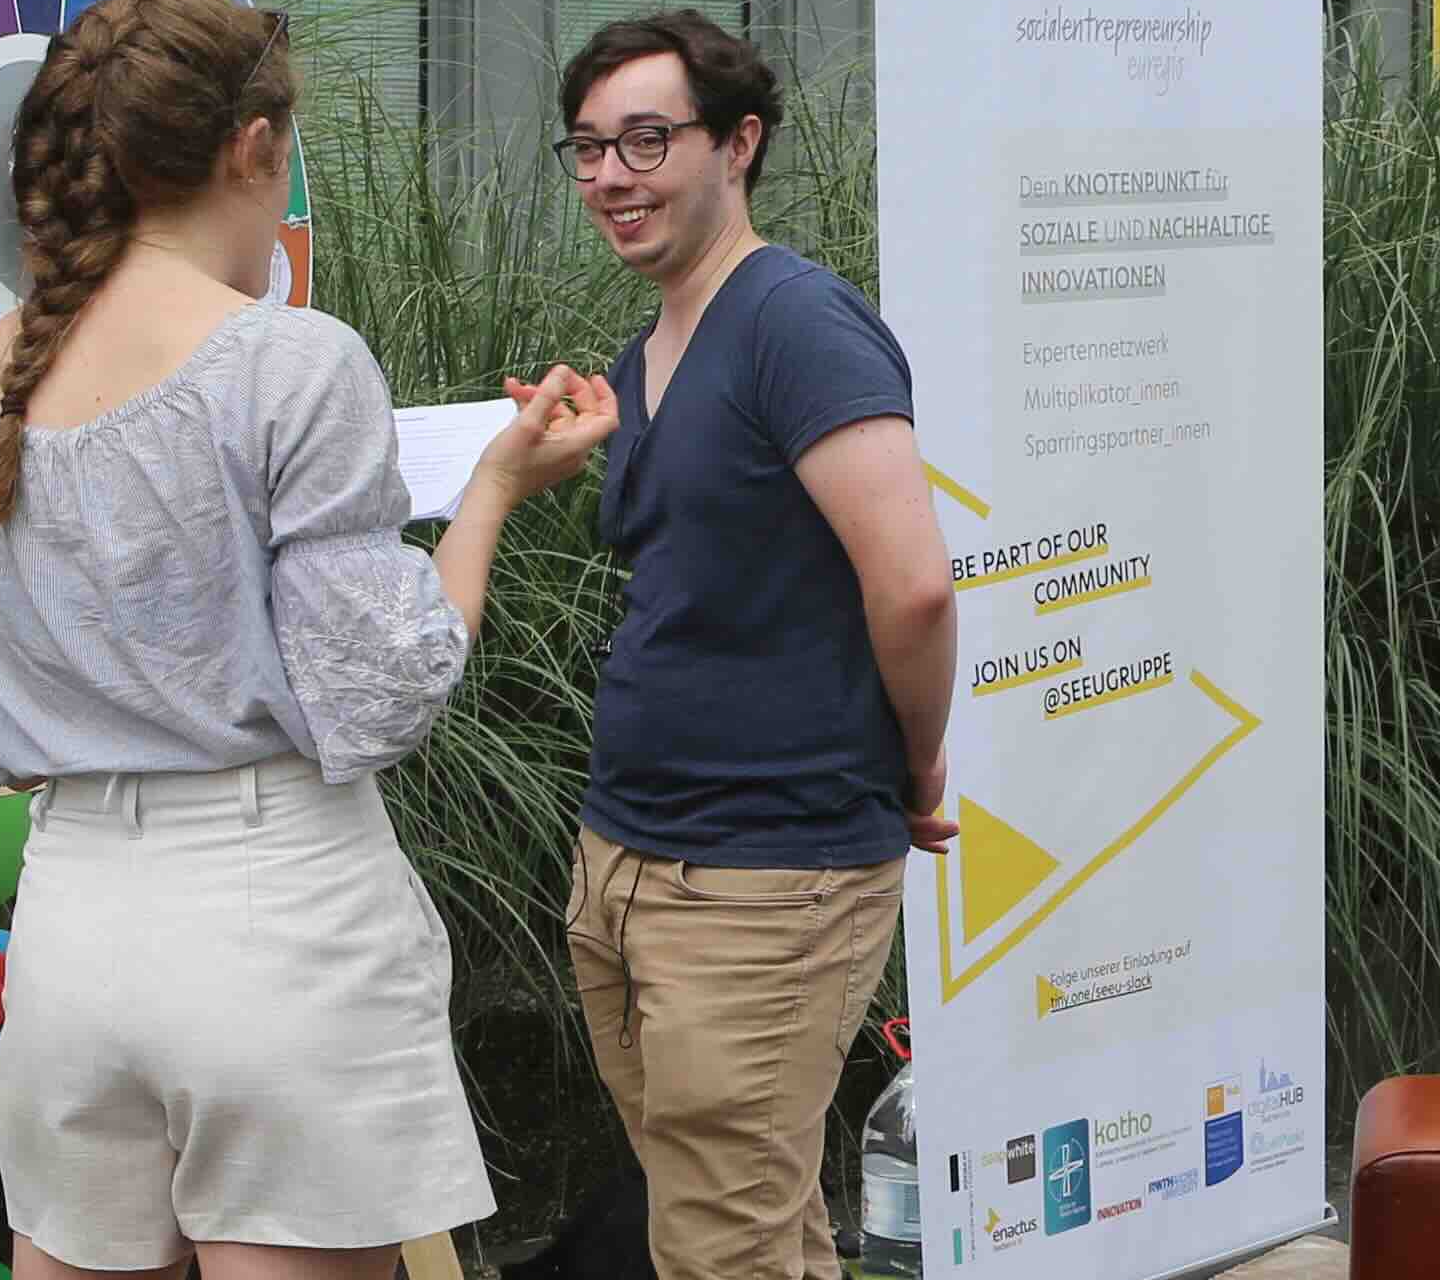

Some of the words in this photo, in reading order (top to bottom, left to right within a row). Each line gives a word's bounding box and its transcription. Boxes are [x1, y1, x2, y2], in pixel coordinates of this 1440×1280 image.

[1015, 4, 1213, 56] socialentrepreneurship
[1019, 173, 1059, 200] Dein
[1064, 169, 1201, 197] KNOTENPUNKT
[1204, 167, 1229, 193] für
[1020, 221, 1098, 249] SOZIALE
[1103, 218, 1146, 244] UND
[1149, 213, 1271, 240] NACHHALTIGE
[1021, 264, 1167, 295] INNOVATIONEN
[1022, 332, 1170, 368] Expertennetzwerk
[1024, 378, 1181, 413] Multiplikator_innen
[1024, 418, 1211, 461] Sparringspartner_innen
[951, 557, 977, 582] BE
[983, 541, 1032, 575] PART
[1036, 534, 1063, 561] OF
[1067, 523, 1108, 554] OUR
[1034, 552, 1152, 606] COMMUNITY
[971, 653, 1019, 688] JOIN
[1024, 645, 1049, 675] US
[1053, 635, 1082, 665] ON
[1043, 651, 1173, 715] @SEEUGRUPPE
[1094, 1109, 1153, 1146] katho
[992, 1217, 1038, 1243] enactus
